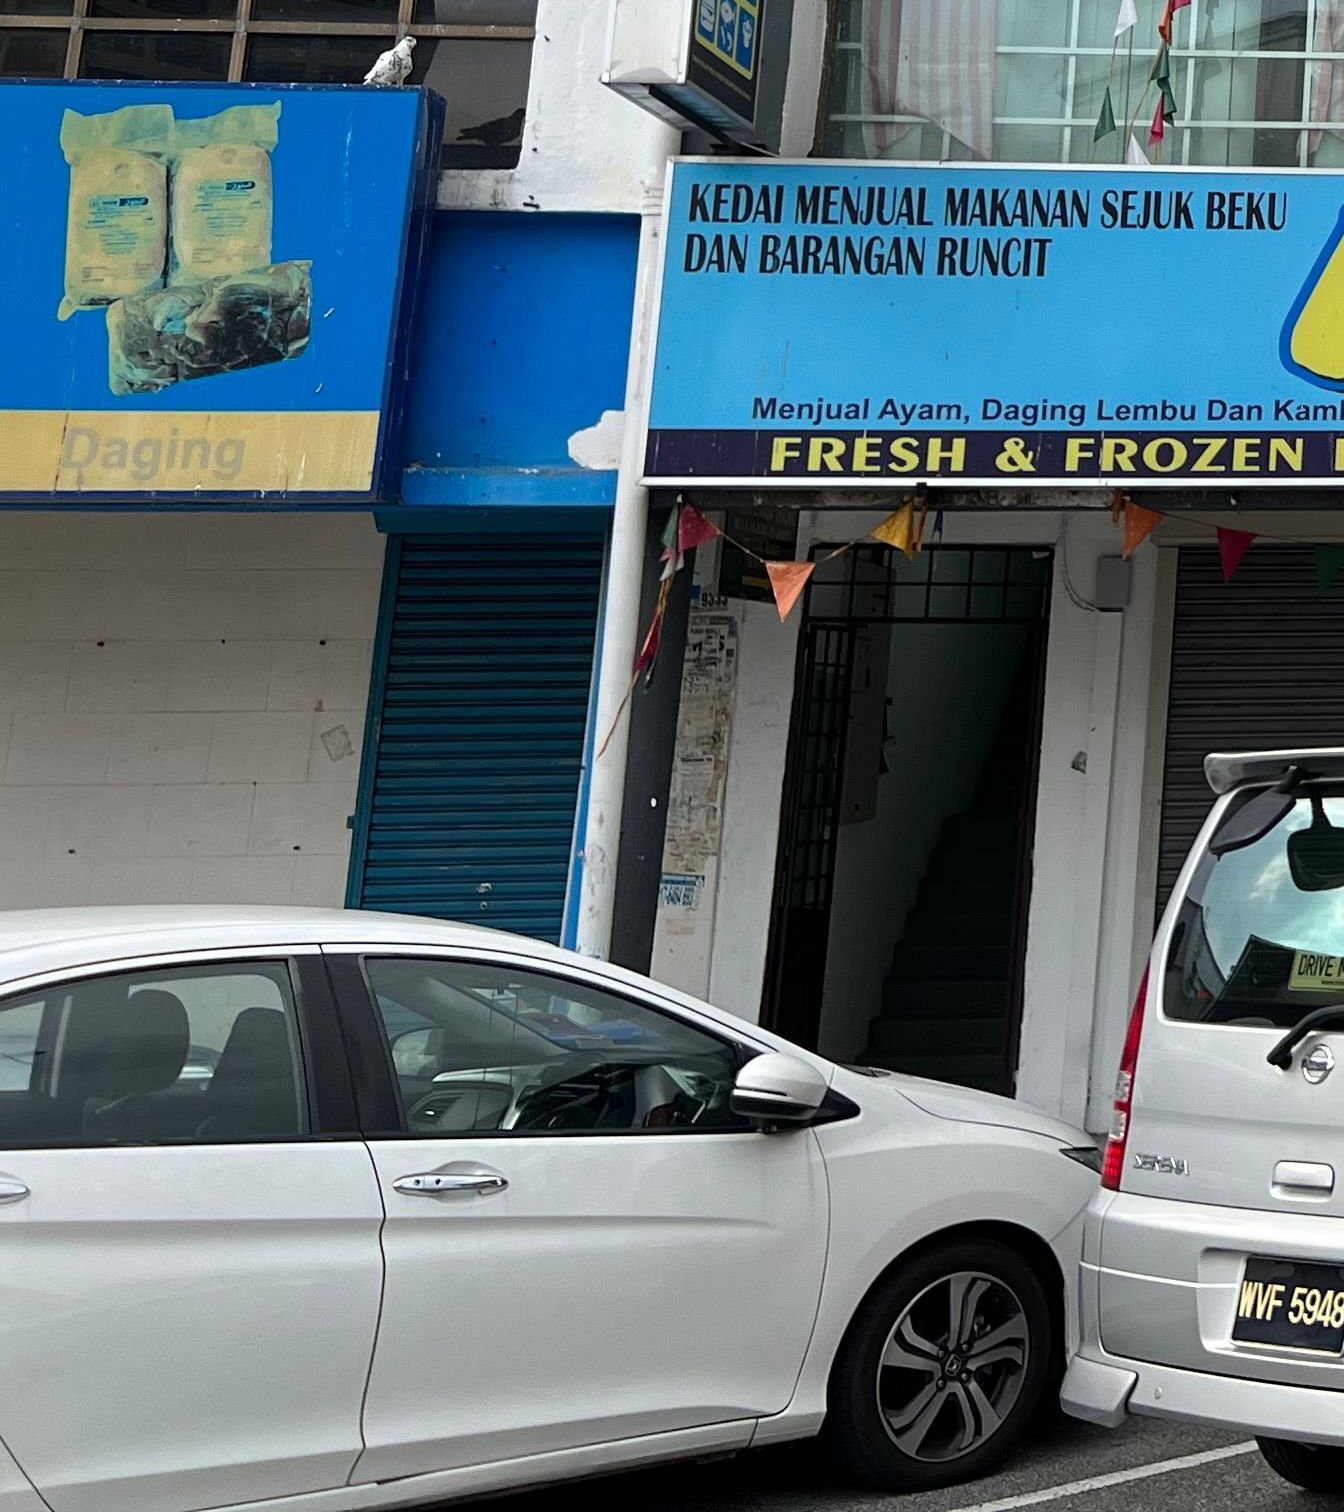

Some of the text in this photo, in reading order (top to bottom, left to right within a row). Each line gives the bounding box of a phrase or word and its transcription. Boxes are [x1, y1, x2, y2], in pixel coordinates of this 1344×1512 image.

[689, 184, 1287, 231] KEDAI MENJUAL MAKANAN SEJUK BEKU
[684, 233, 1052, 277] DAN BARANGAN RUNCIT
[752, 397, 869, 426] Menjual
[877, 398, 970, 426] Ayam,
[981, 399, 1086, 427] Daging
[1098, 399, 1196, 421] Lembu
[1207, 400, 1262, 421] Dan
[62, 427, 246, 481] Daging
[770, 437, 966, 473] FRESH
[995, 437, 1036, 473] &
[1065, 437, 1304, 473] FROZEN
[1298, 954, 1335, 977] DRIVE
[1240, 1279, 1285, 1321] WVF
